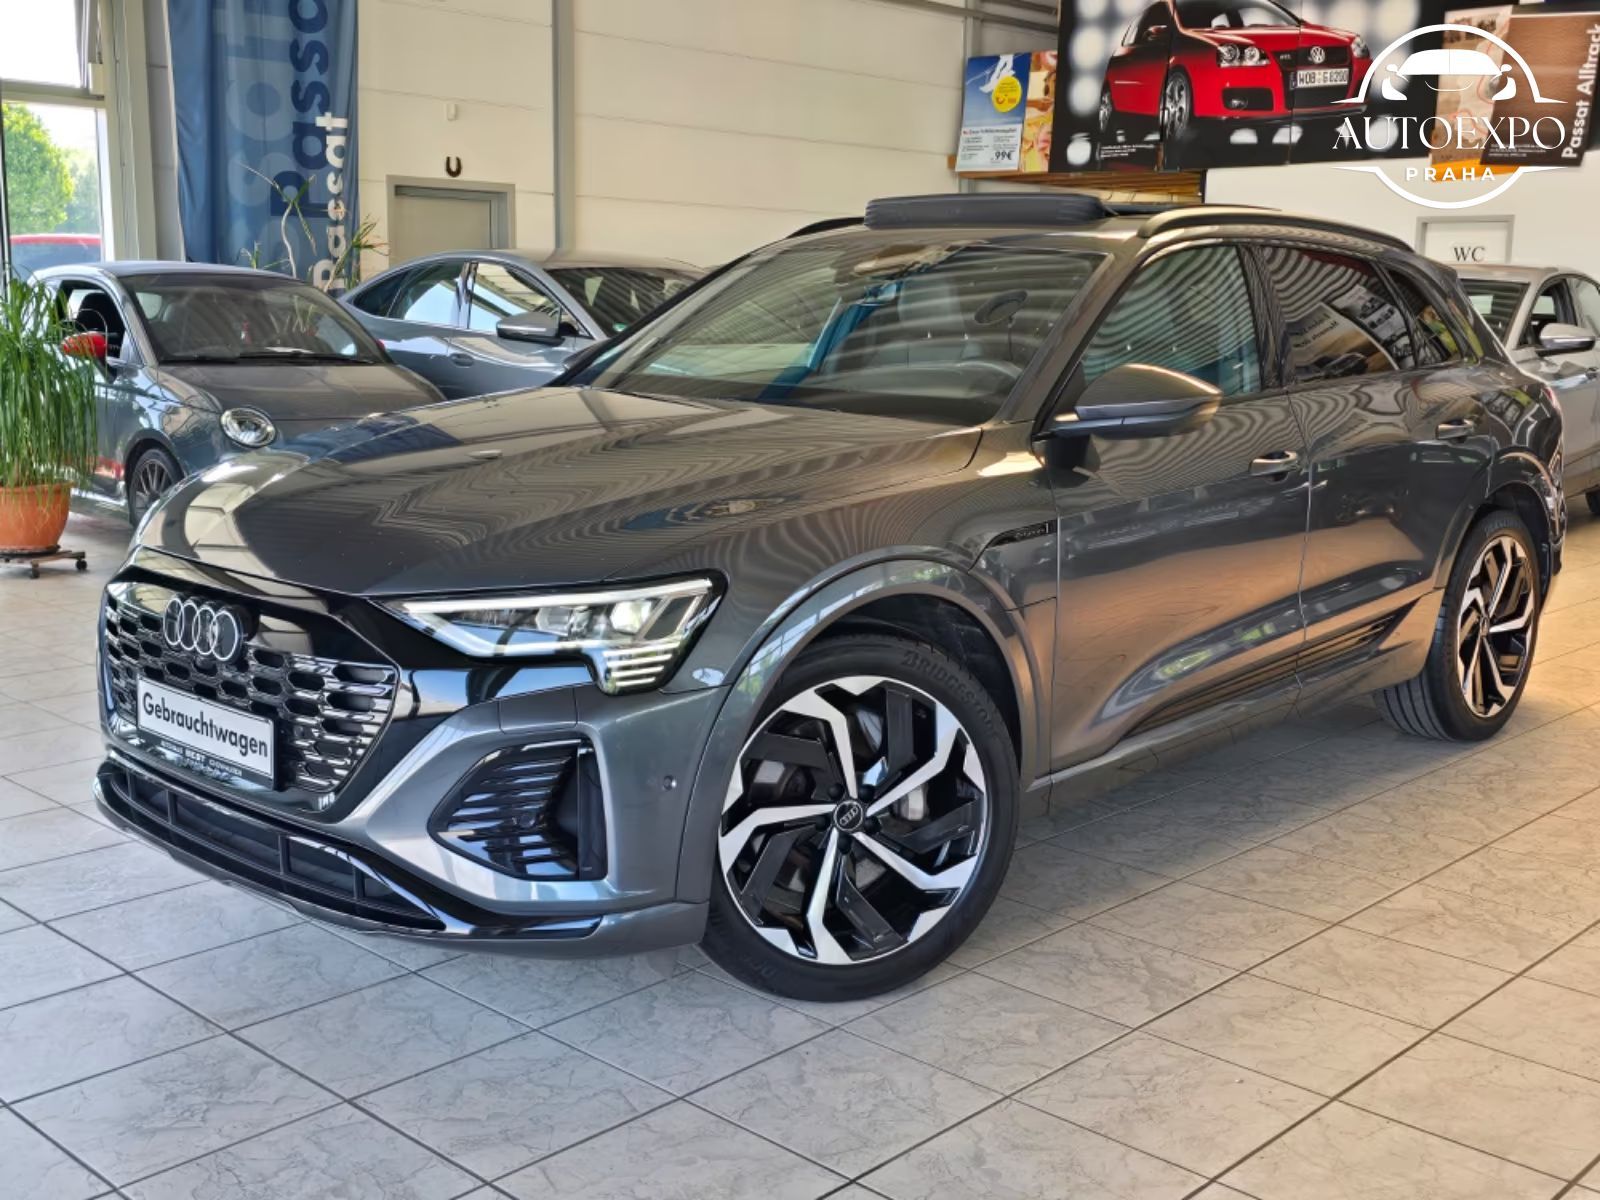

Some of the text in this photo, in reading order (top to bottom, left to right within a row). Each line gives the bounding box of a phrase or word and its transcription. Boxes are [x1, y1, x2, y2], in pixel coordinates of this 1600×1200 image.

[1561, 24, 1600, 158] Passat Alltrack
[1453, 246, 1486, 263] WC
[143, 692, 268, 757] Gebrauchtwagen
